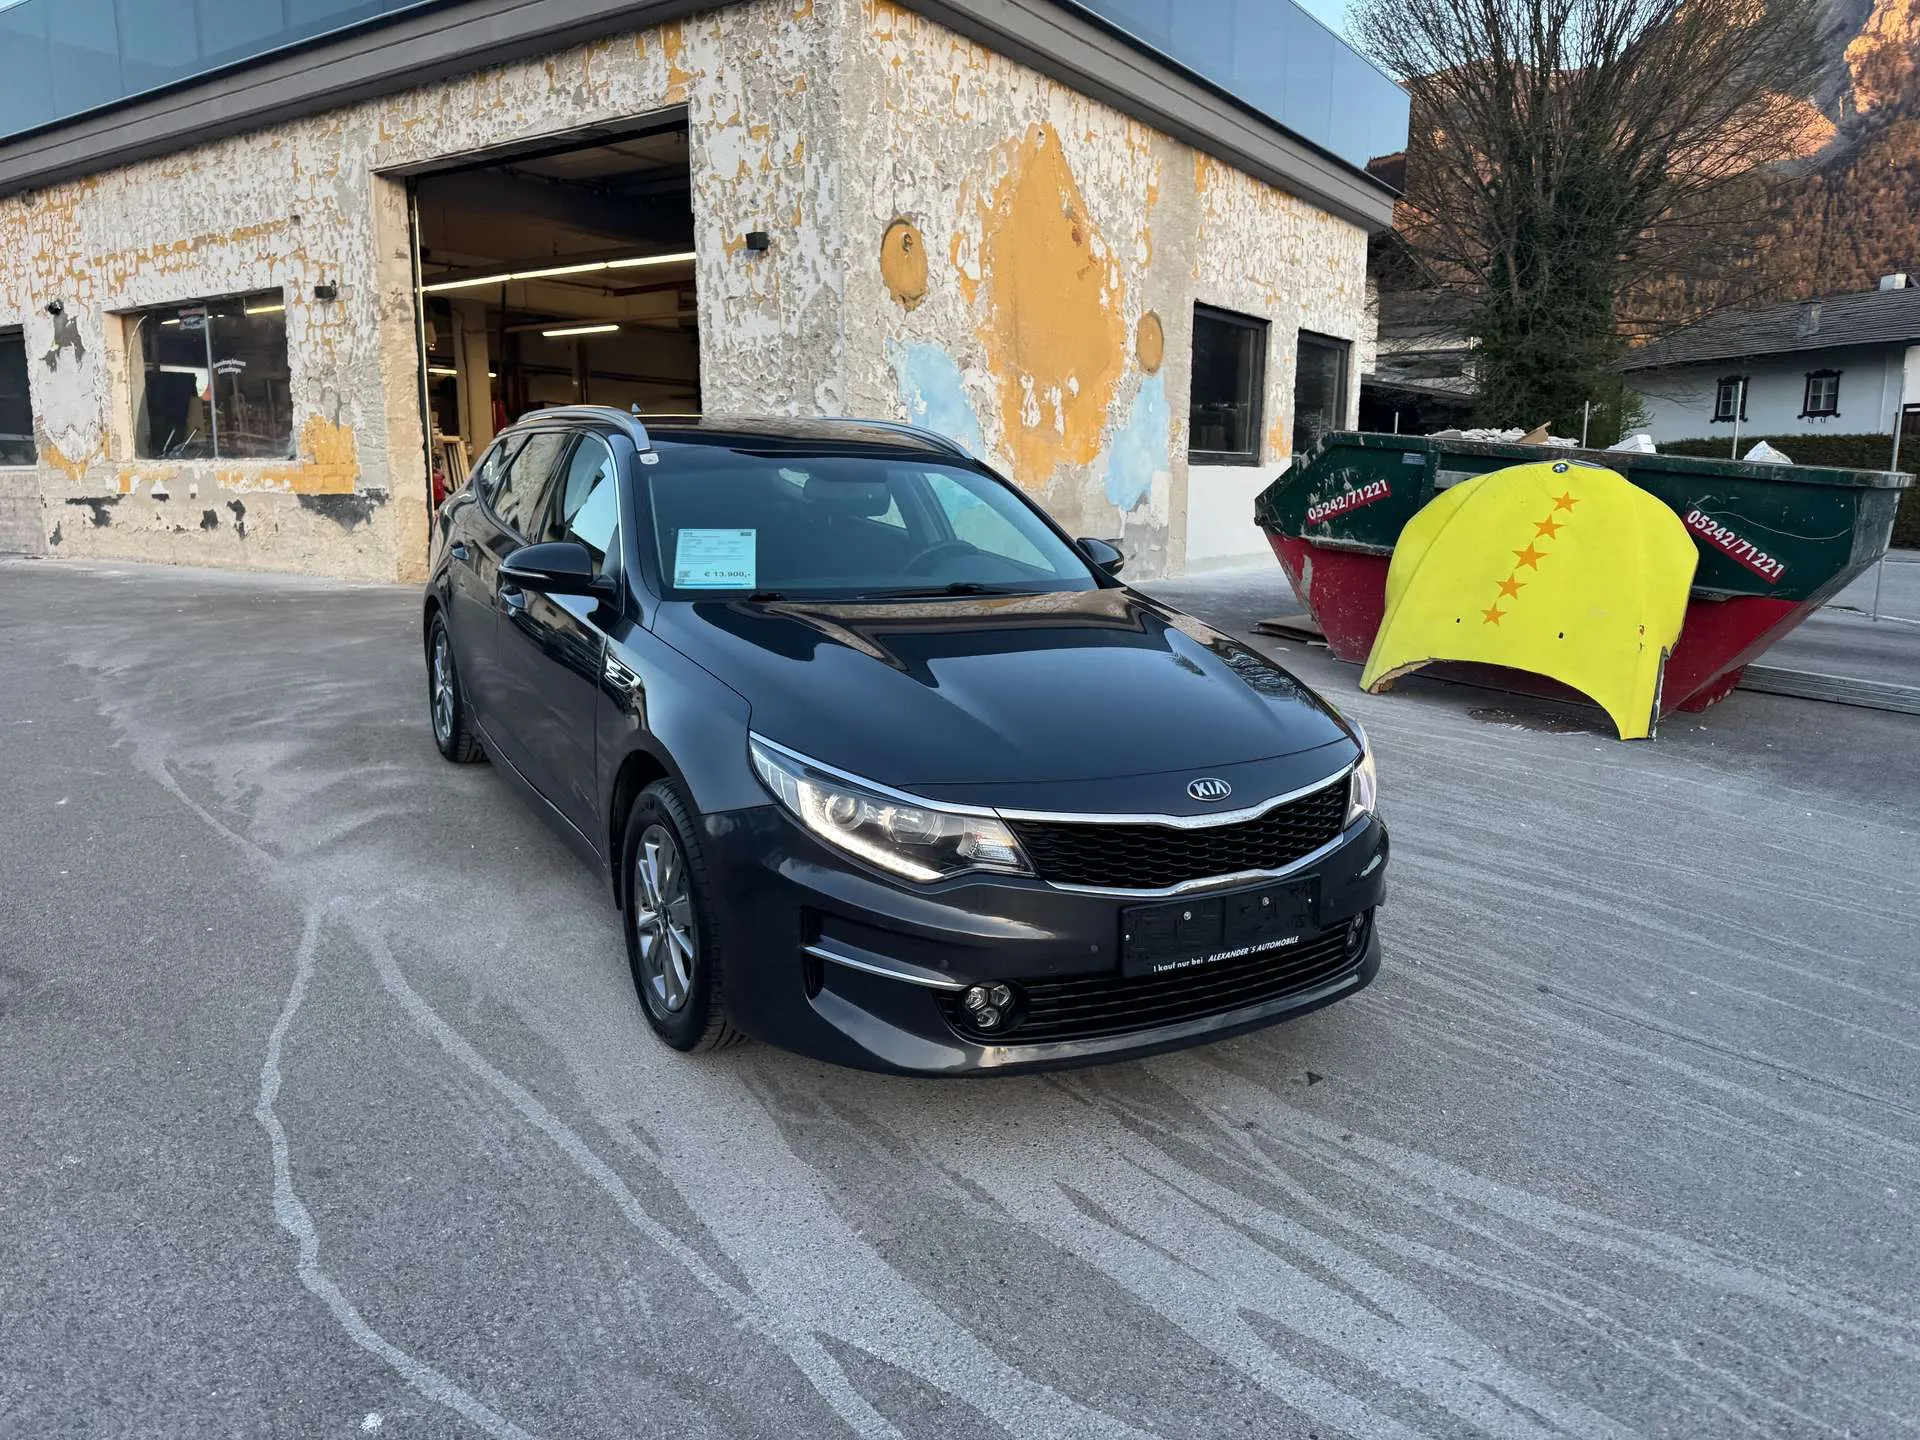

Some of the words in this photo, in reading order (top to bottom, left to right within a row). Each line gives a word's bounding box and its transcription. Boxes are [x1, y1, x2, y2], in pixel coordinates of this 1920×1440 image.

[1307, 479, 1388, 520] 05242/71221
[1687, 510, 1785, 578] 05242/71221
[1193, 781, 1228, 797] KIA
[1158, 961, 1176, 972] kauf
[1177, 960, 1190, 968] nur
[1256, 935, 1300, 953] AUTOMOBILE
